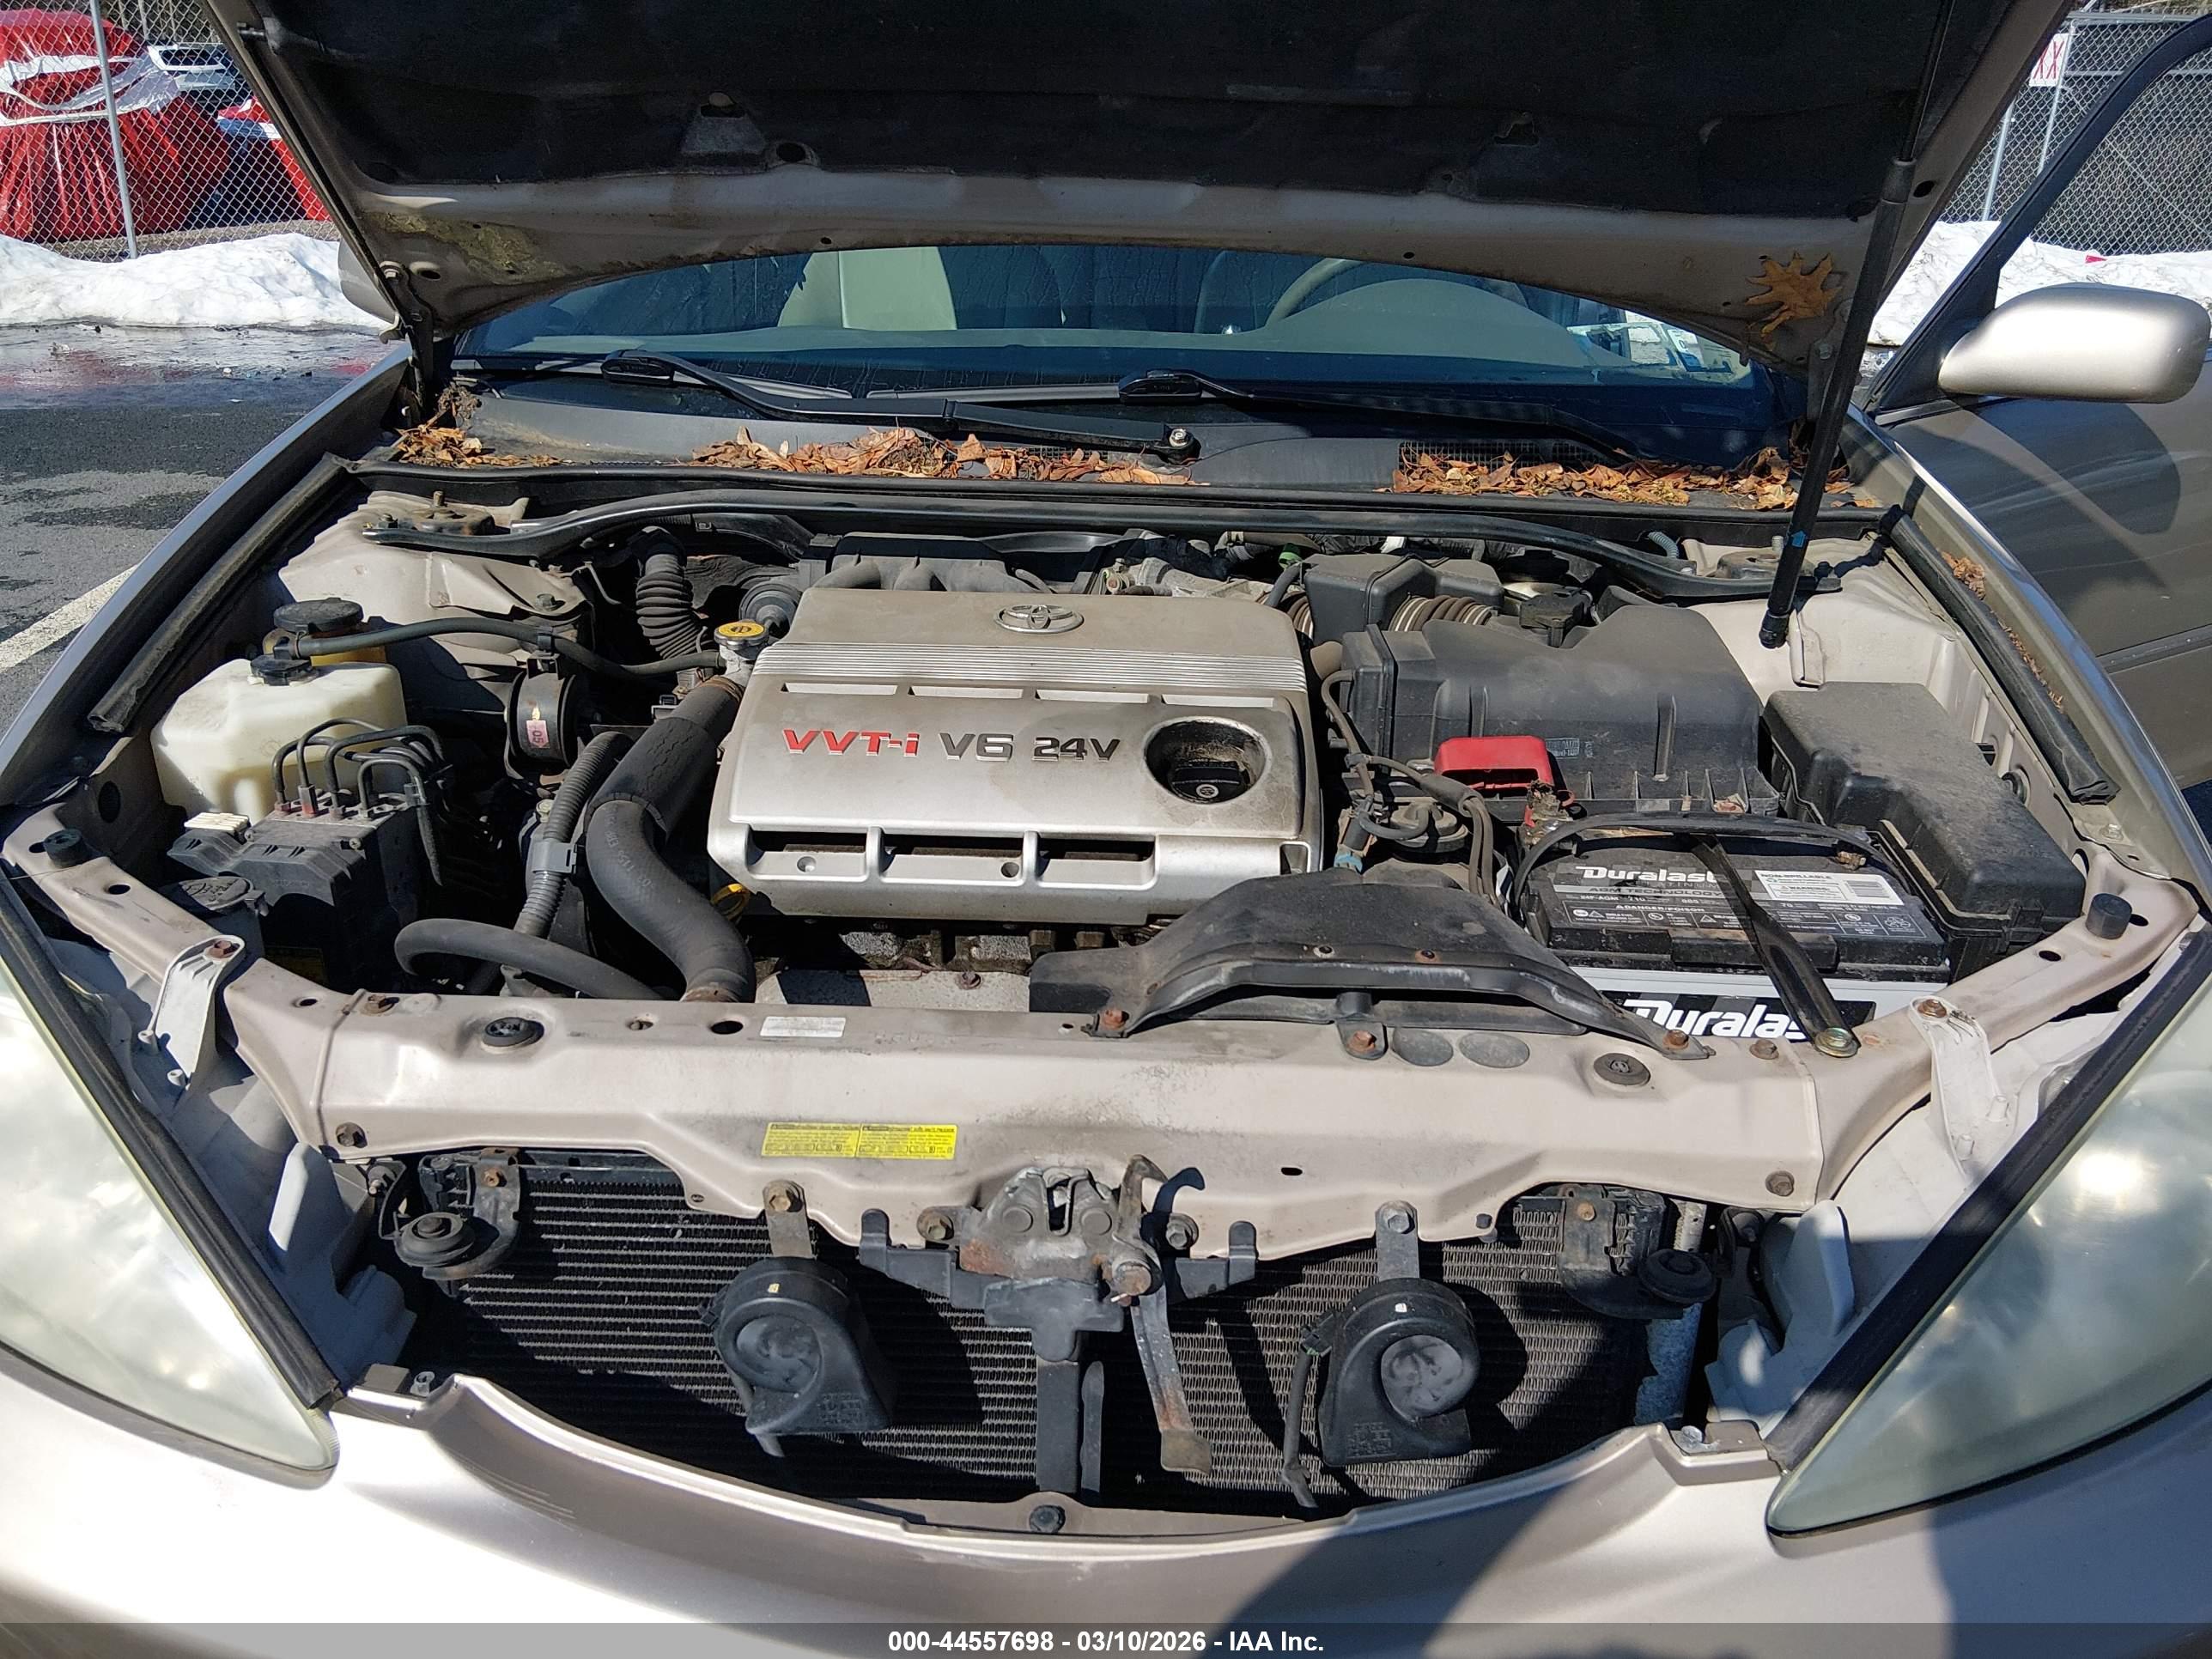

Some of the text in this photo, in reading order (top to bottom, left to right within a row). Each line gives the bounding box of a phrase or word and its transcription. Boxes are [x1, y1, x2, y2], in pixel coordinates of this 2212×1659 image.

[783, 729, 1121, 763] VVT-i V6 24V
[1576, 866, 1717, 884] Duralast
[1623, 999, 1807, 1040] Duralas
